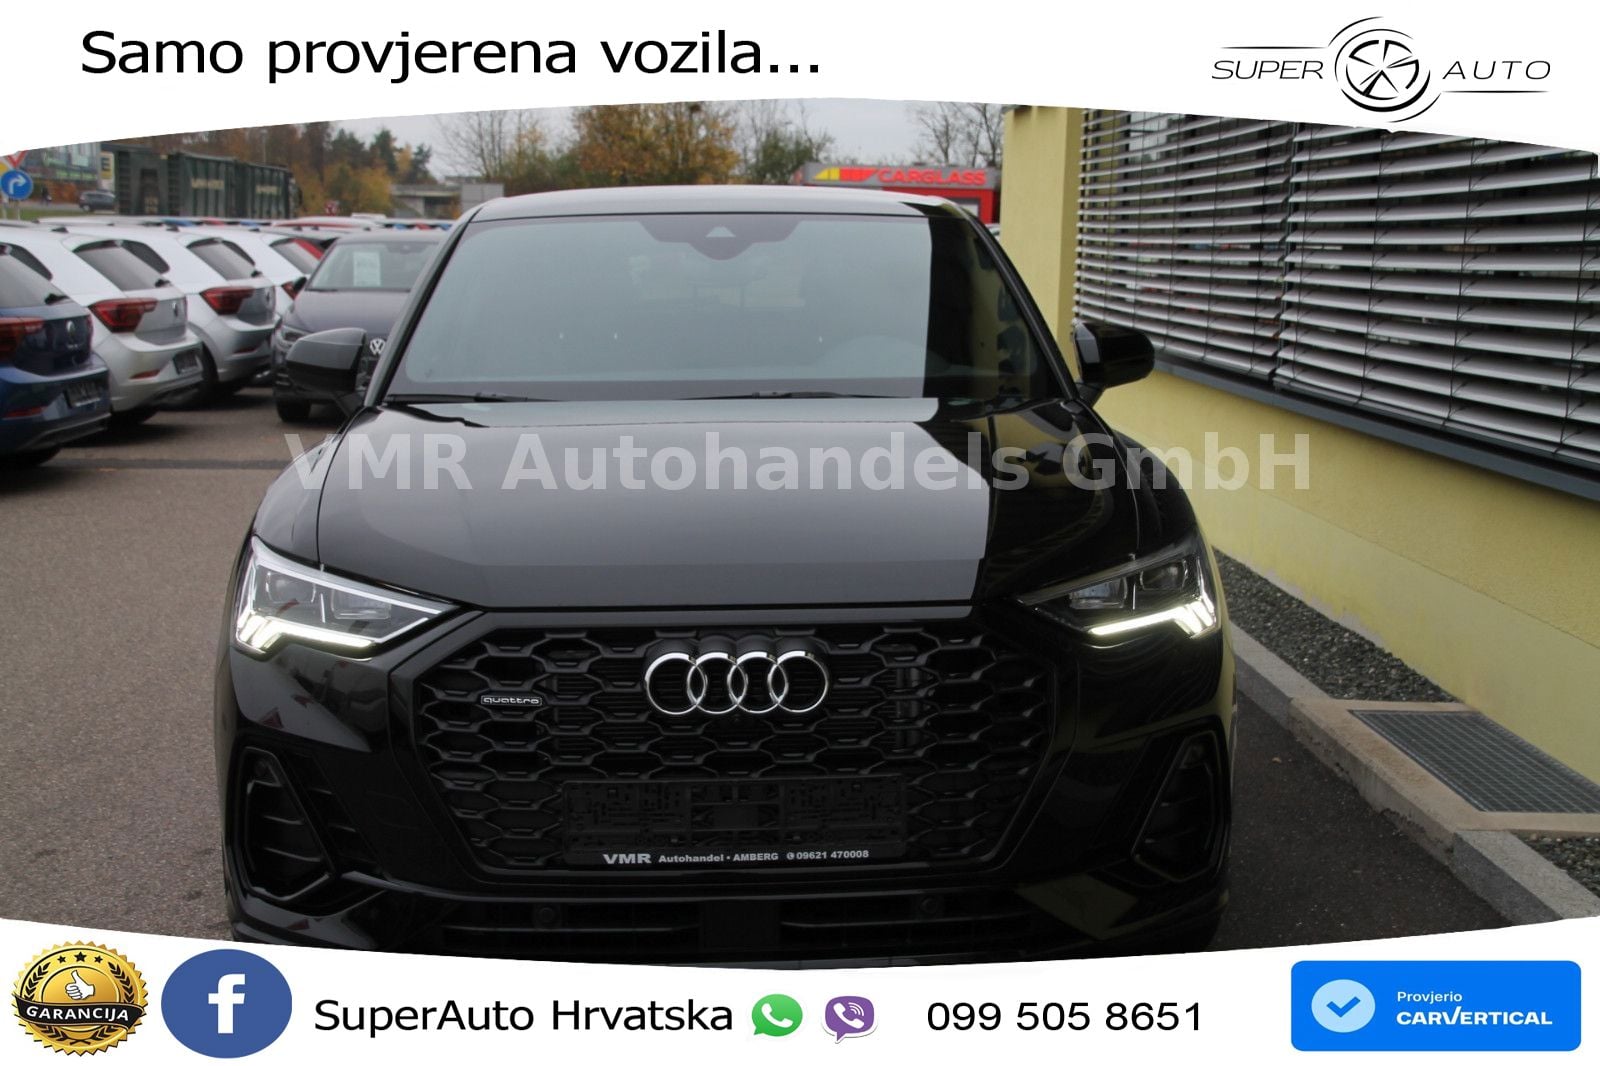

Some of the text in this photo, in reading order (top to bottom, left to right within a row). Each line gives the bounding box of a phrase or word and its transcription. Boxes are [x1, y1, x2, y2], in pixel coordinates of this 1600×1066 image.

[877, 168, 986, 186] CARGLASS
[483, 696, 540, 705] quattro
[602, 849, 870, 865] VMR Autohandel AMBERG 09621 470008
